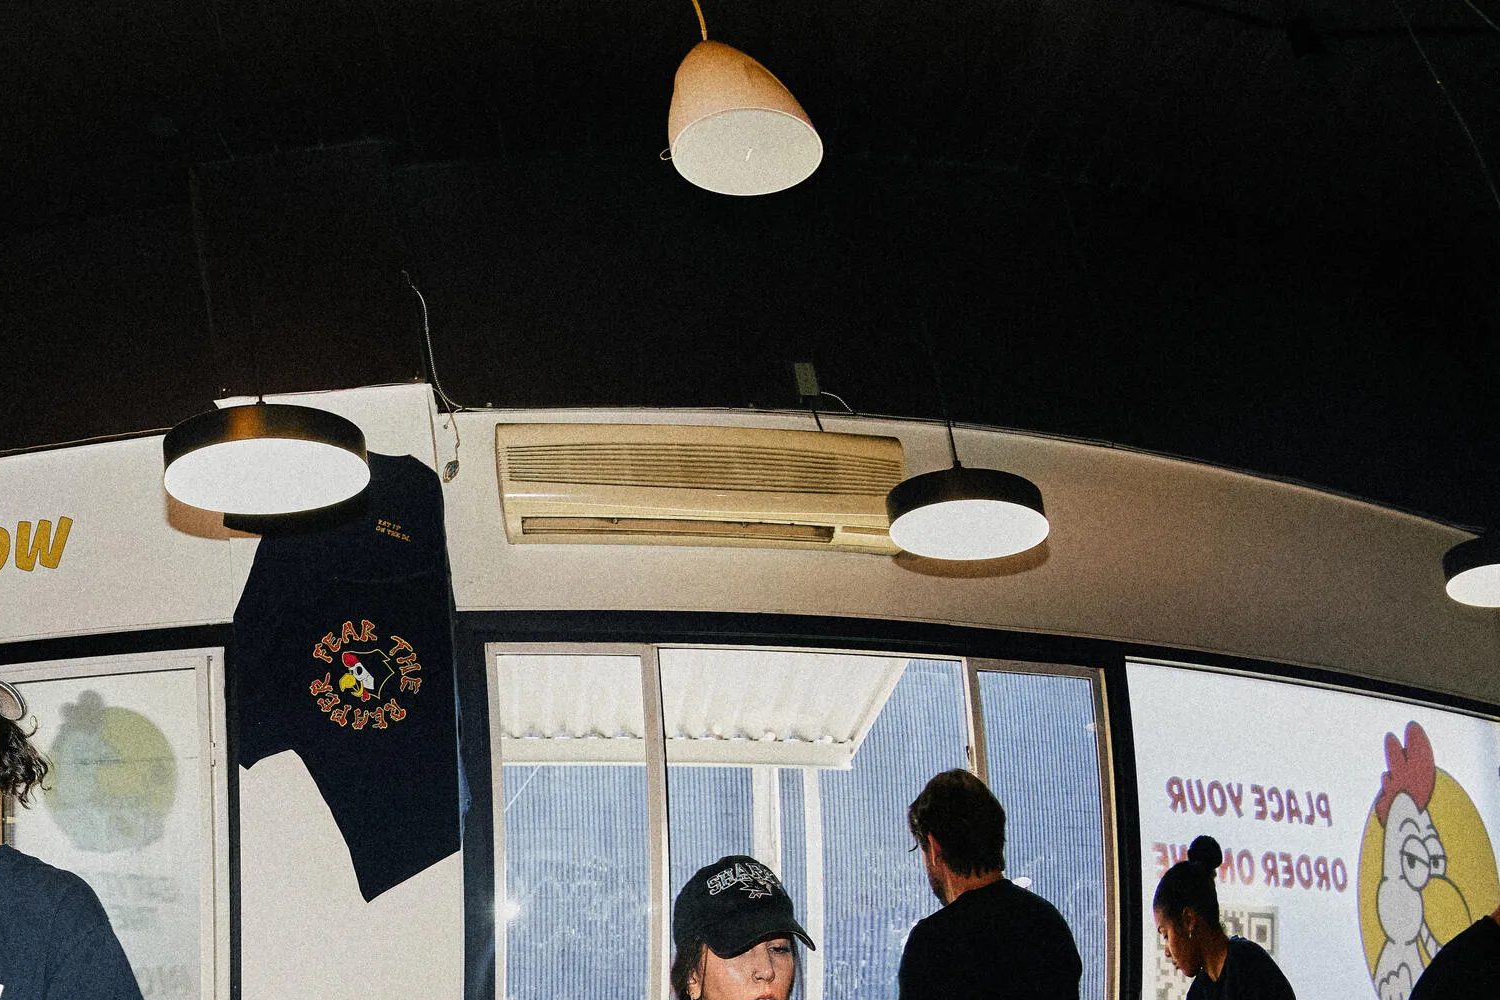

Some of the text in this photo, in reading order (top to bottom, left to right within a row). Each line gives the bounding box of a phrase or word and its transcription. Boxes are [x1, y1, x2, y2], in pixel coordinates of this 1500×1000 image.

[309, 619, 422, 730] FEAR THE REAPER
